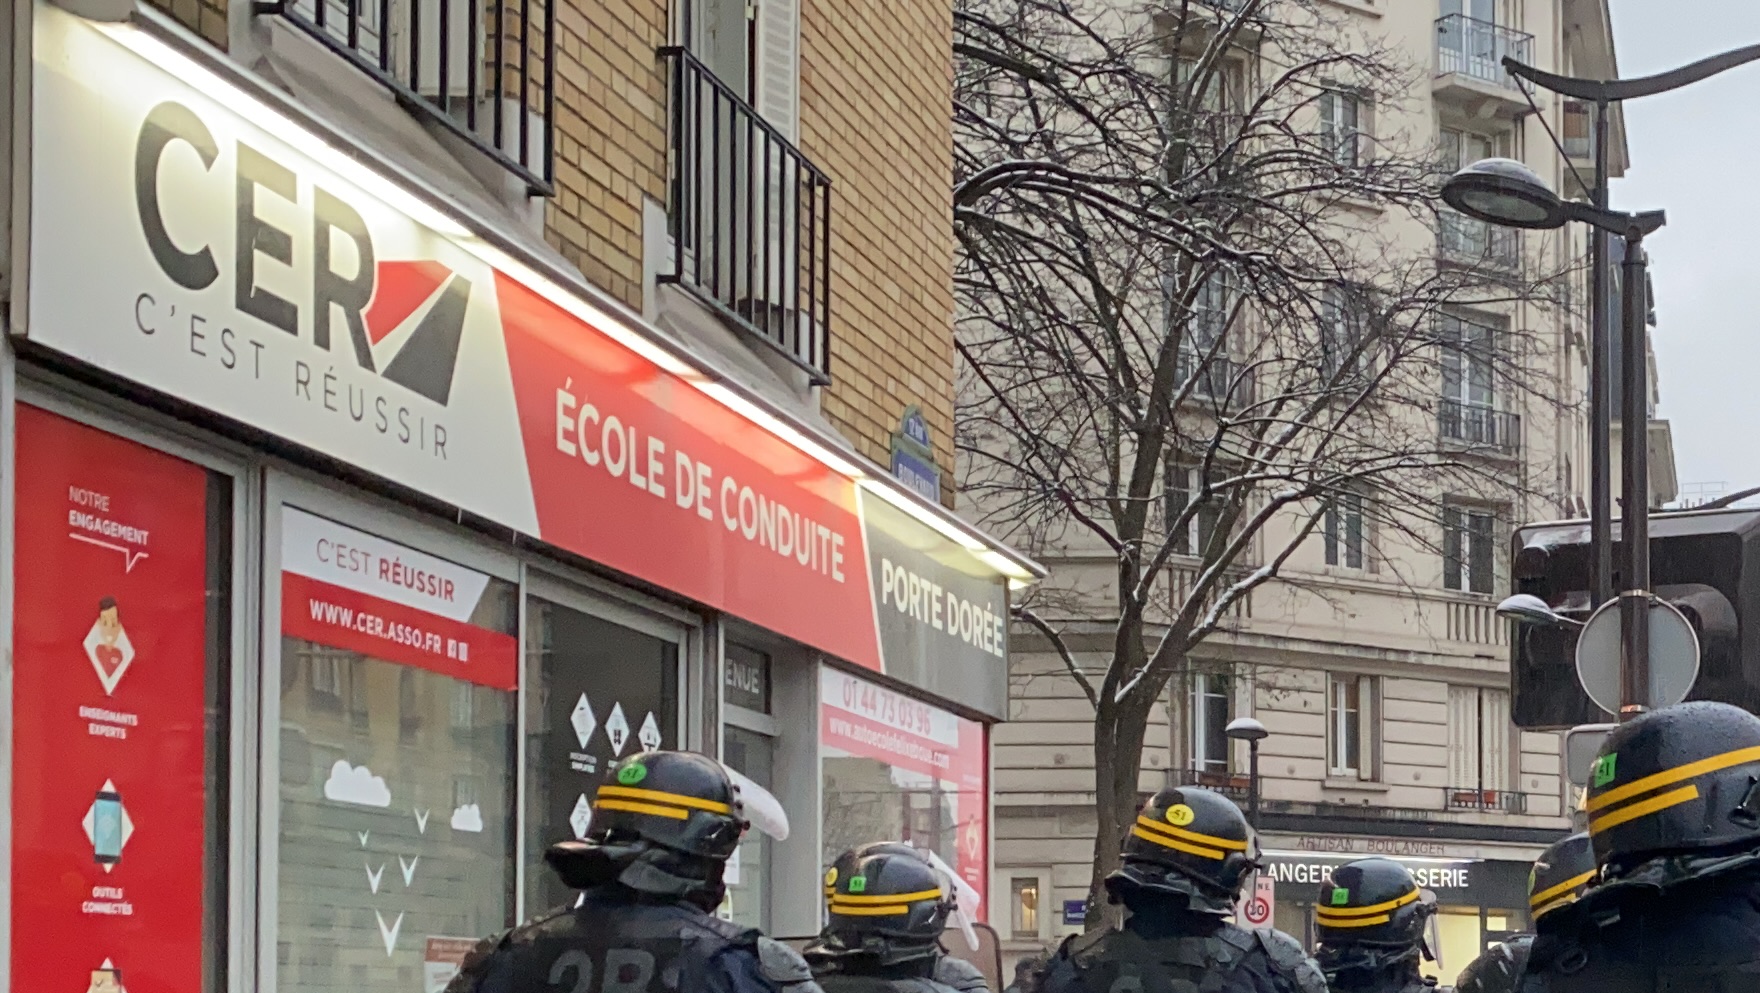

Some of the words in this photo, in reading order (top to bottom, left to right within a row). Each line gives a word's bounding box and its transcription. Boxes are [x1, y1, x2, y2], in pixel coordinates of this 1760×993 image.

[135, 100, 377, 374] CER
[135, 293, 264, 379] C'EST
[295, 366, 447, 460] RÉUSSIR
[69, 485, 110, 512] NOTRE
[556, 376, 665, 498] ÉCOLE
[675, 450, 713, 521] DE
[720, 476, 845, 583] CONDUITE
[69, 509, 149, 546] ENGAGEMENT
[316, 538, 371, 575] C'EST
[379, 556, 455, 602] RÉUSSIR
[309, 598, 441, 654] WWW.CER.ASSO.FR
[882, 558, 943, 631] PORTE
[947, 591, 1003, 658] DORÉE
[843, 679, 857, 710] 01
[861, 685, 878, 717] 44
[1296, 836, 1354, 852] ARTISAN
[1366, 839, 1444, 856] BOULANGER
